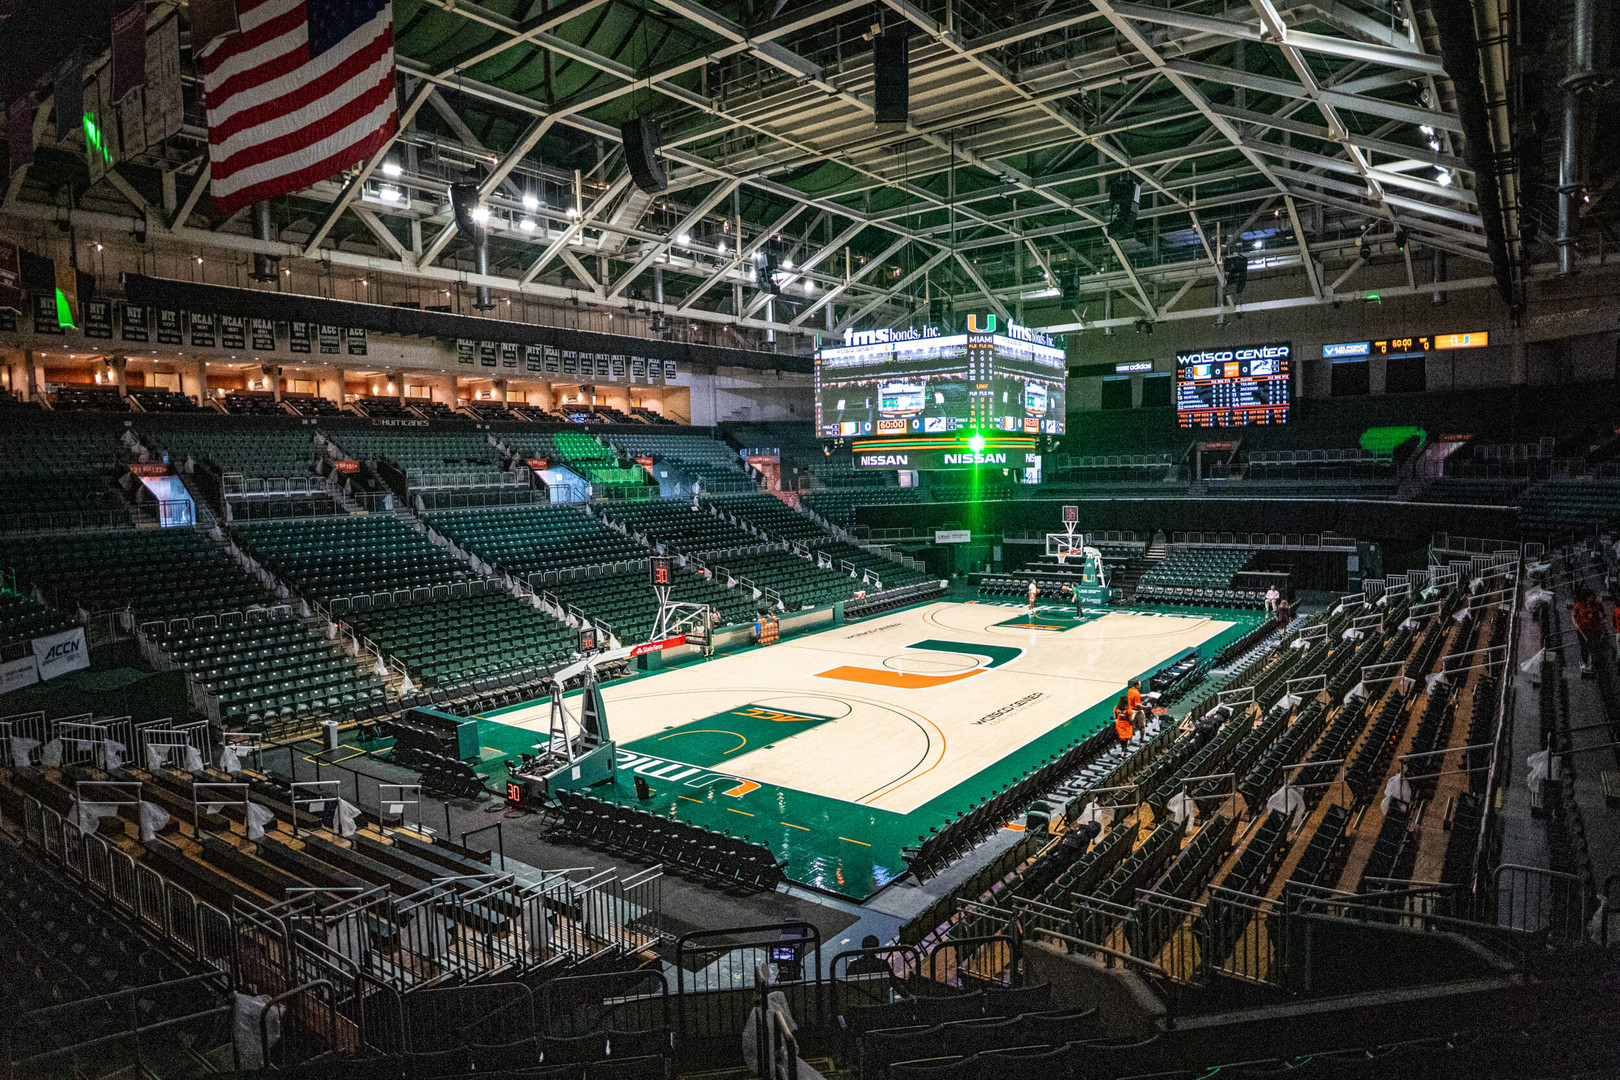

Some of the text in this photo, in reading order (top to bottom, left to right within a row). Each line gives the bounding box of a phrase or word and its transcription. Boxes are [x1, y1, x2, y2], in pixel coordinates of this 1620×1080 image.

[127, 307, 141, 318] NIT
[161, 310, 175, 321] NIT
[192, 313, 212, 325] NCAA
[222, 315, 243, 327] NCAA
[252, 318, 272, 329] NCAA
[322, 325, 337, 334] ACC
[922, 325, 941, 338] Inc.
[969, 336, 992, 344] MIAMI
[1392, 339, 1412, 348] 60:00
[1424, 342, 1429, 350] 0
[865, 423, 871, 431] 0
[880, 420, 904, 428] 60:00
[912, 420, 919, 428] 0
[860, 455, 908, 466] NISSAN
[944, 453, 1006, 464] NISSAN
[1066, 512, 1075, 521] 30
[656, 568, 668, 583] 30
[1083, 574, 1095, 582] U
[45, 639, 79, 659] ACCN
[507, 783, 520, 801] 30
